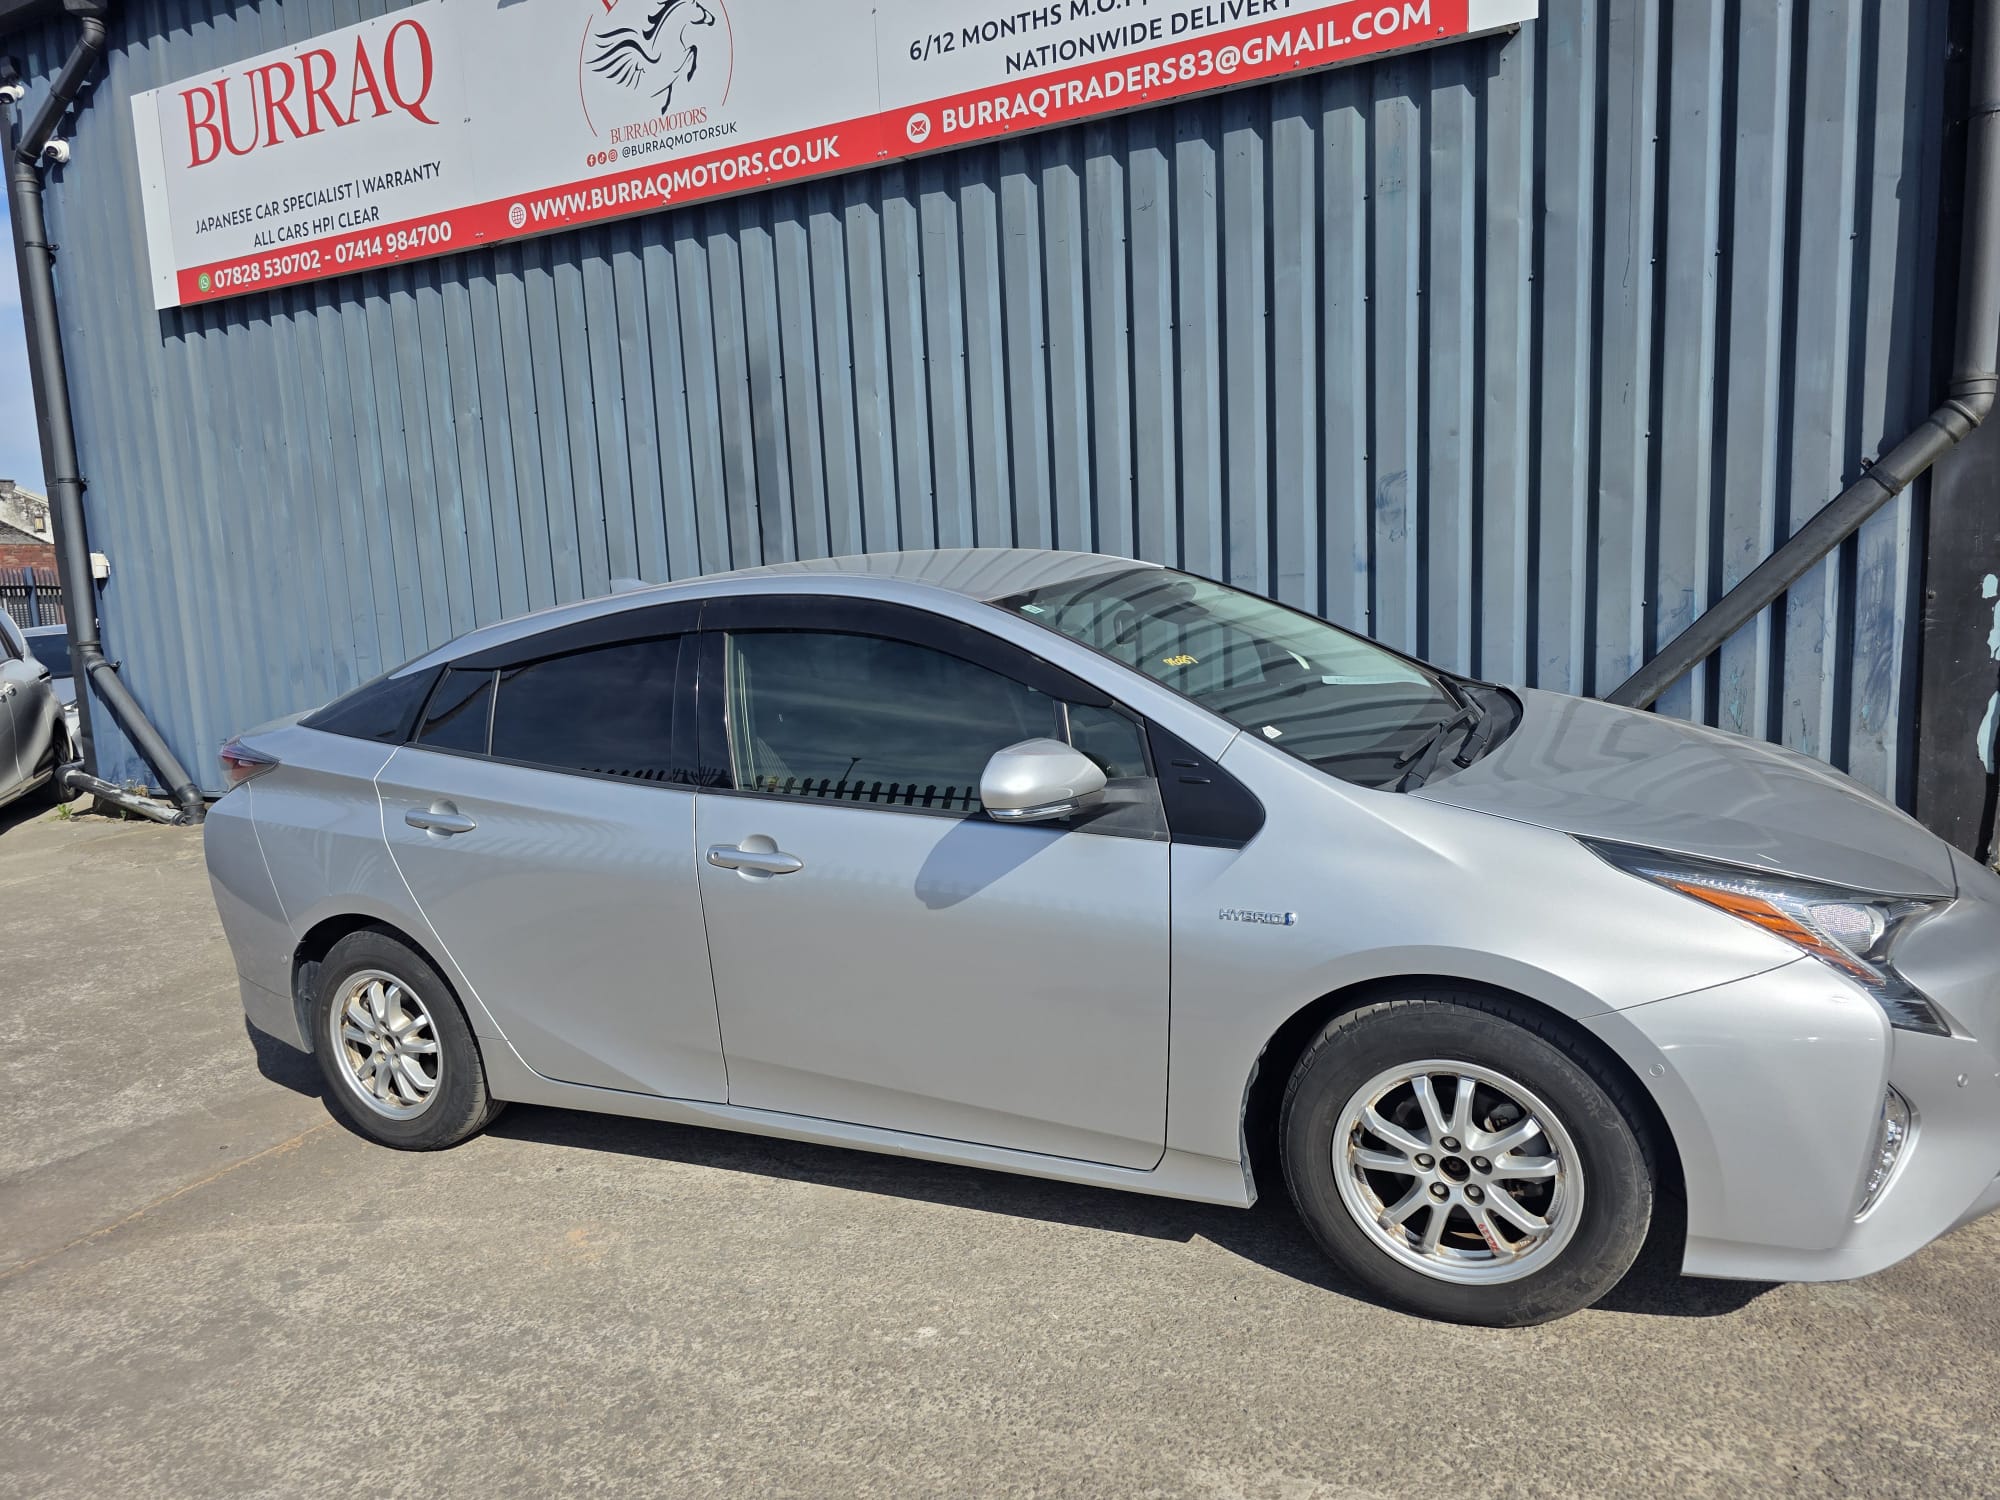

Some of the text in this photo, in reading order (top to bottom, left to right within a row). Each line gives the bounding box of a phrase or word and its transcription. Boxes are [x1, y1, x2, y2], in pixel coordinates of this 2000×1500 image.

[909, 31, 955, 62] 6/12
[962, 3, 1062, 48] MONTHS
[1006, 17, 1163, 75] NATIONWIDE
[178, 19, 440, 169] BURRAQ
[942, 0, 1432, 133] BURRAQTRADERS83@GMAIL.COM
[621, 121, 738, 158] @BURRAQMOTORSUK
[195, 207, 253, 234] JAPANESE
[255, 201, 280, 220] CAR
[282, 182, 353, 214] SPECIALIST
[362, 160, 442, 194] WARRANTY
[530, 135, 841, 222] WWW.BURRAQMOTORS.CO.UK
[214, 264, 261, 289] 07828
[263, 249, 321, 280] 530702
[335, 236, 384, 264] 07414
[386, 220, 453, 254] 984700
[253, 205, 380, 248] ALL CARS HPI CLEAR
[1218, 908, 1282, 926] HYBRID
